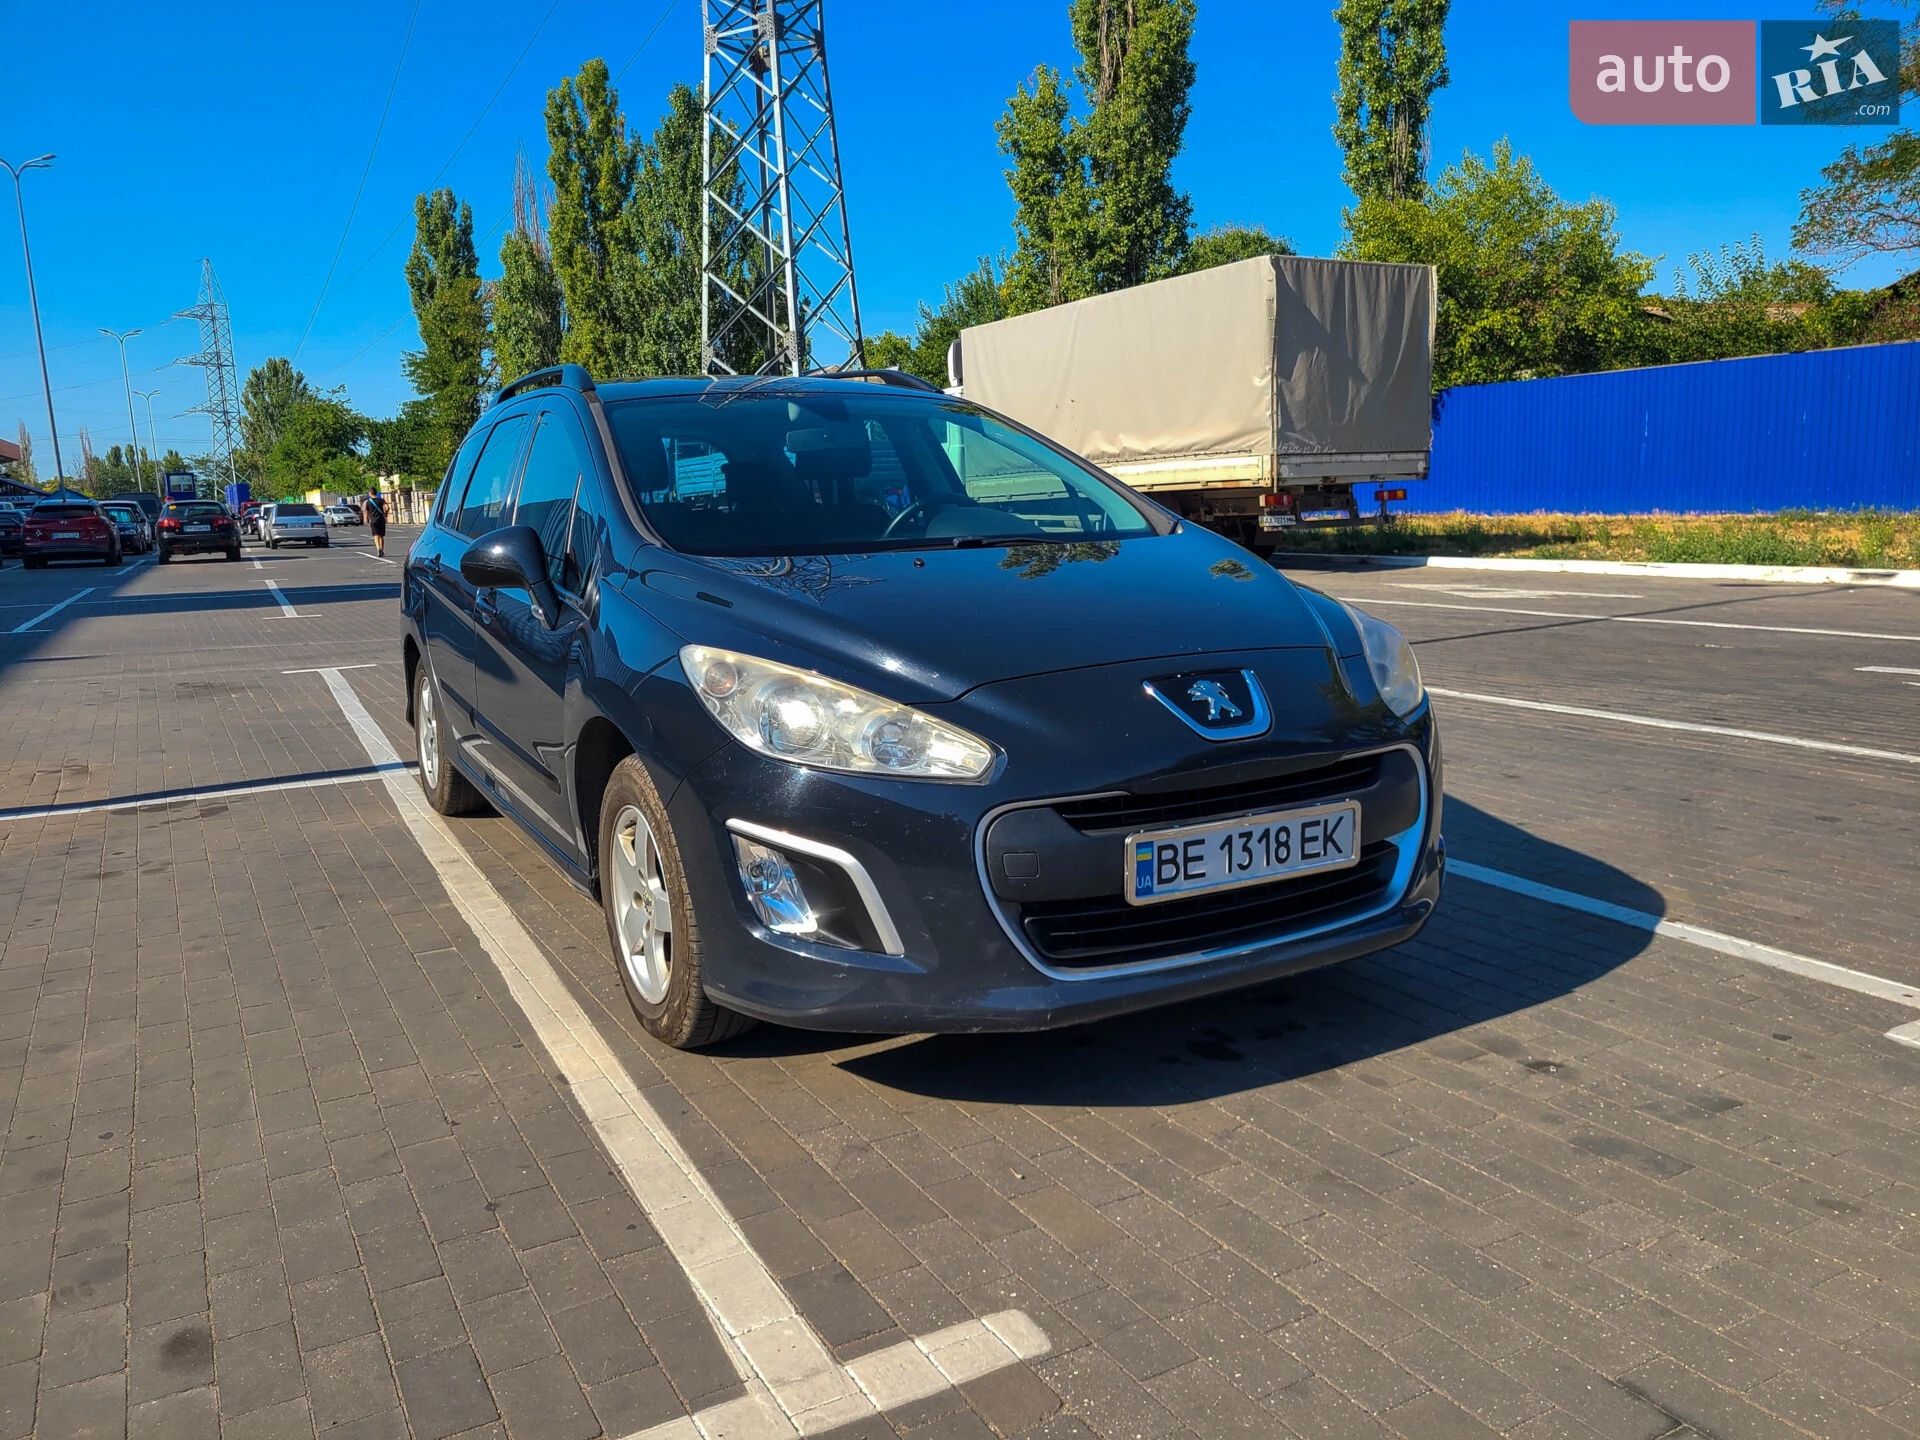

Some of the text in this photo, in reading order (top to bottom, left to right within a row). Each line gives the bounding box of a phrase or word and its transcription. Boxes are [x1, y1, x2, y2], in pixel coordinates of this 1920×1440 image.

[1156, 816, 1345, 886] BE 1318 EK
[1136, 875, 1152, 889] UA
